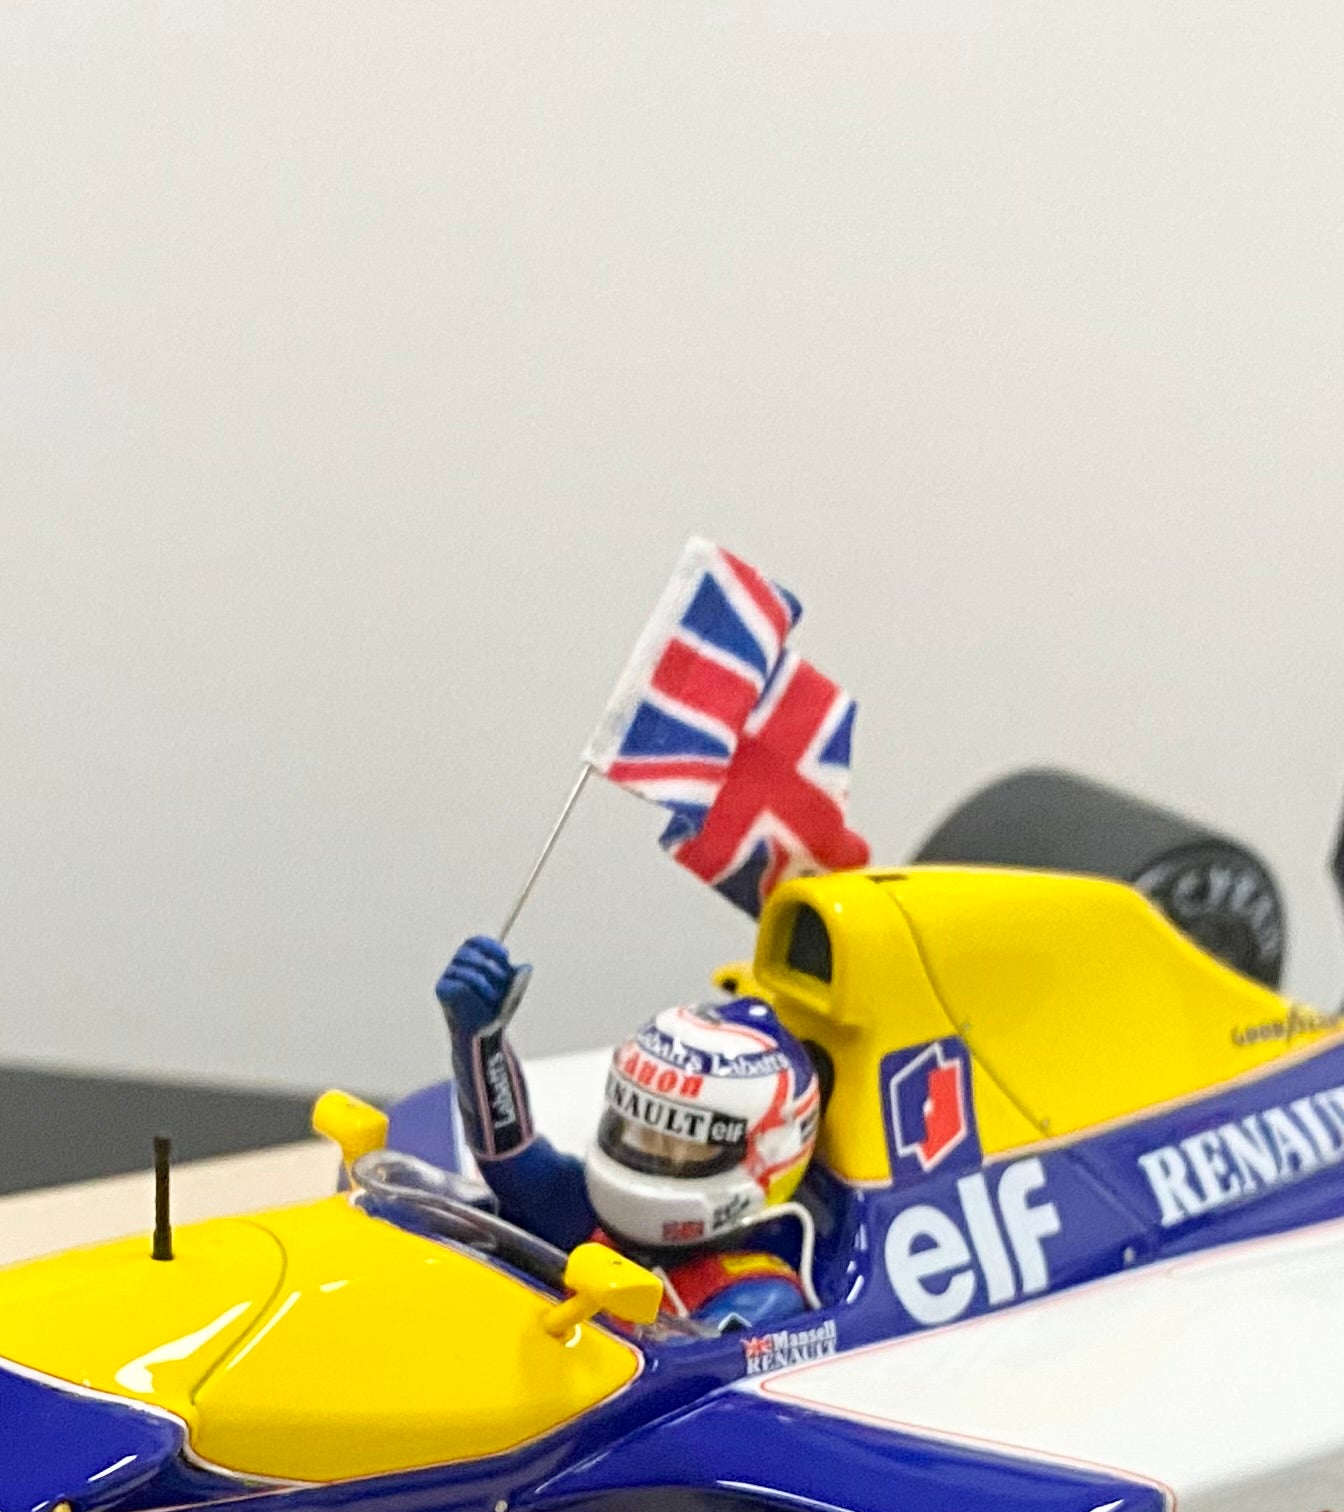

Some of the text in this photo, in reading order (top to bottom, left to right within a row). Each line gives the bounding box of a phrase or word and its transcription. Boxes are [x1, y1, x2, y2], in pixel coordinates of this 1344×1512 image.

[884, 1159, 1061, 1326] elf
[772, 1320, 835, 1350] Mansell
[747, 1338, 836, 1374] RENAULT
